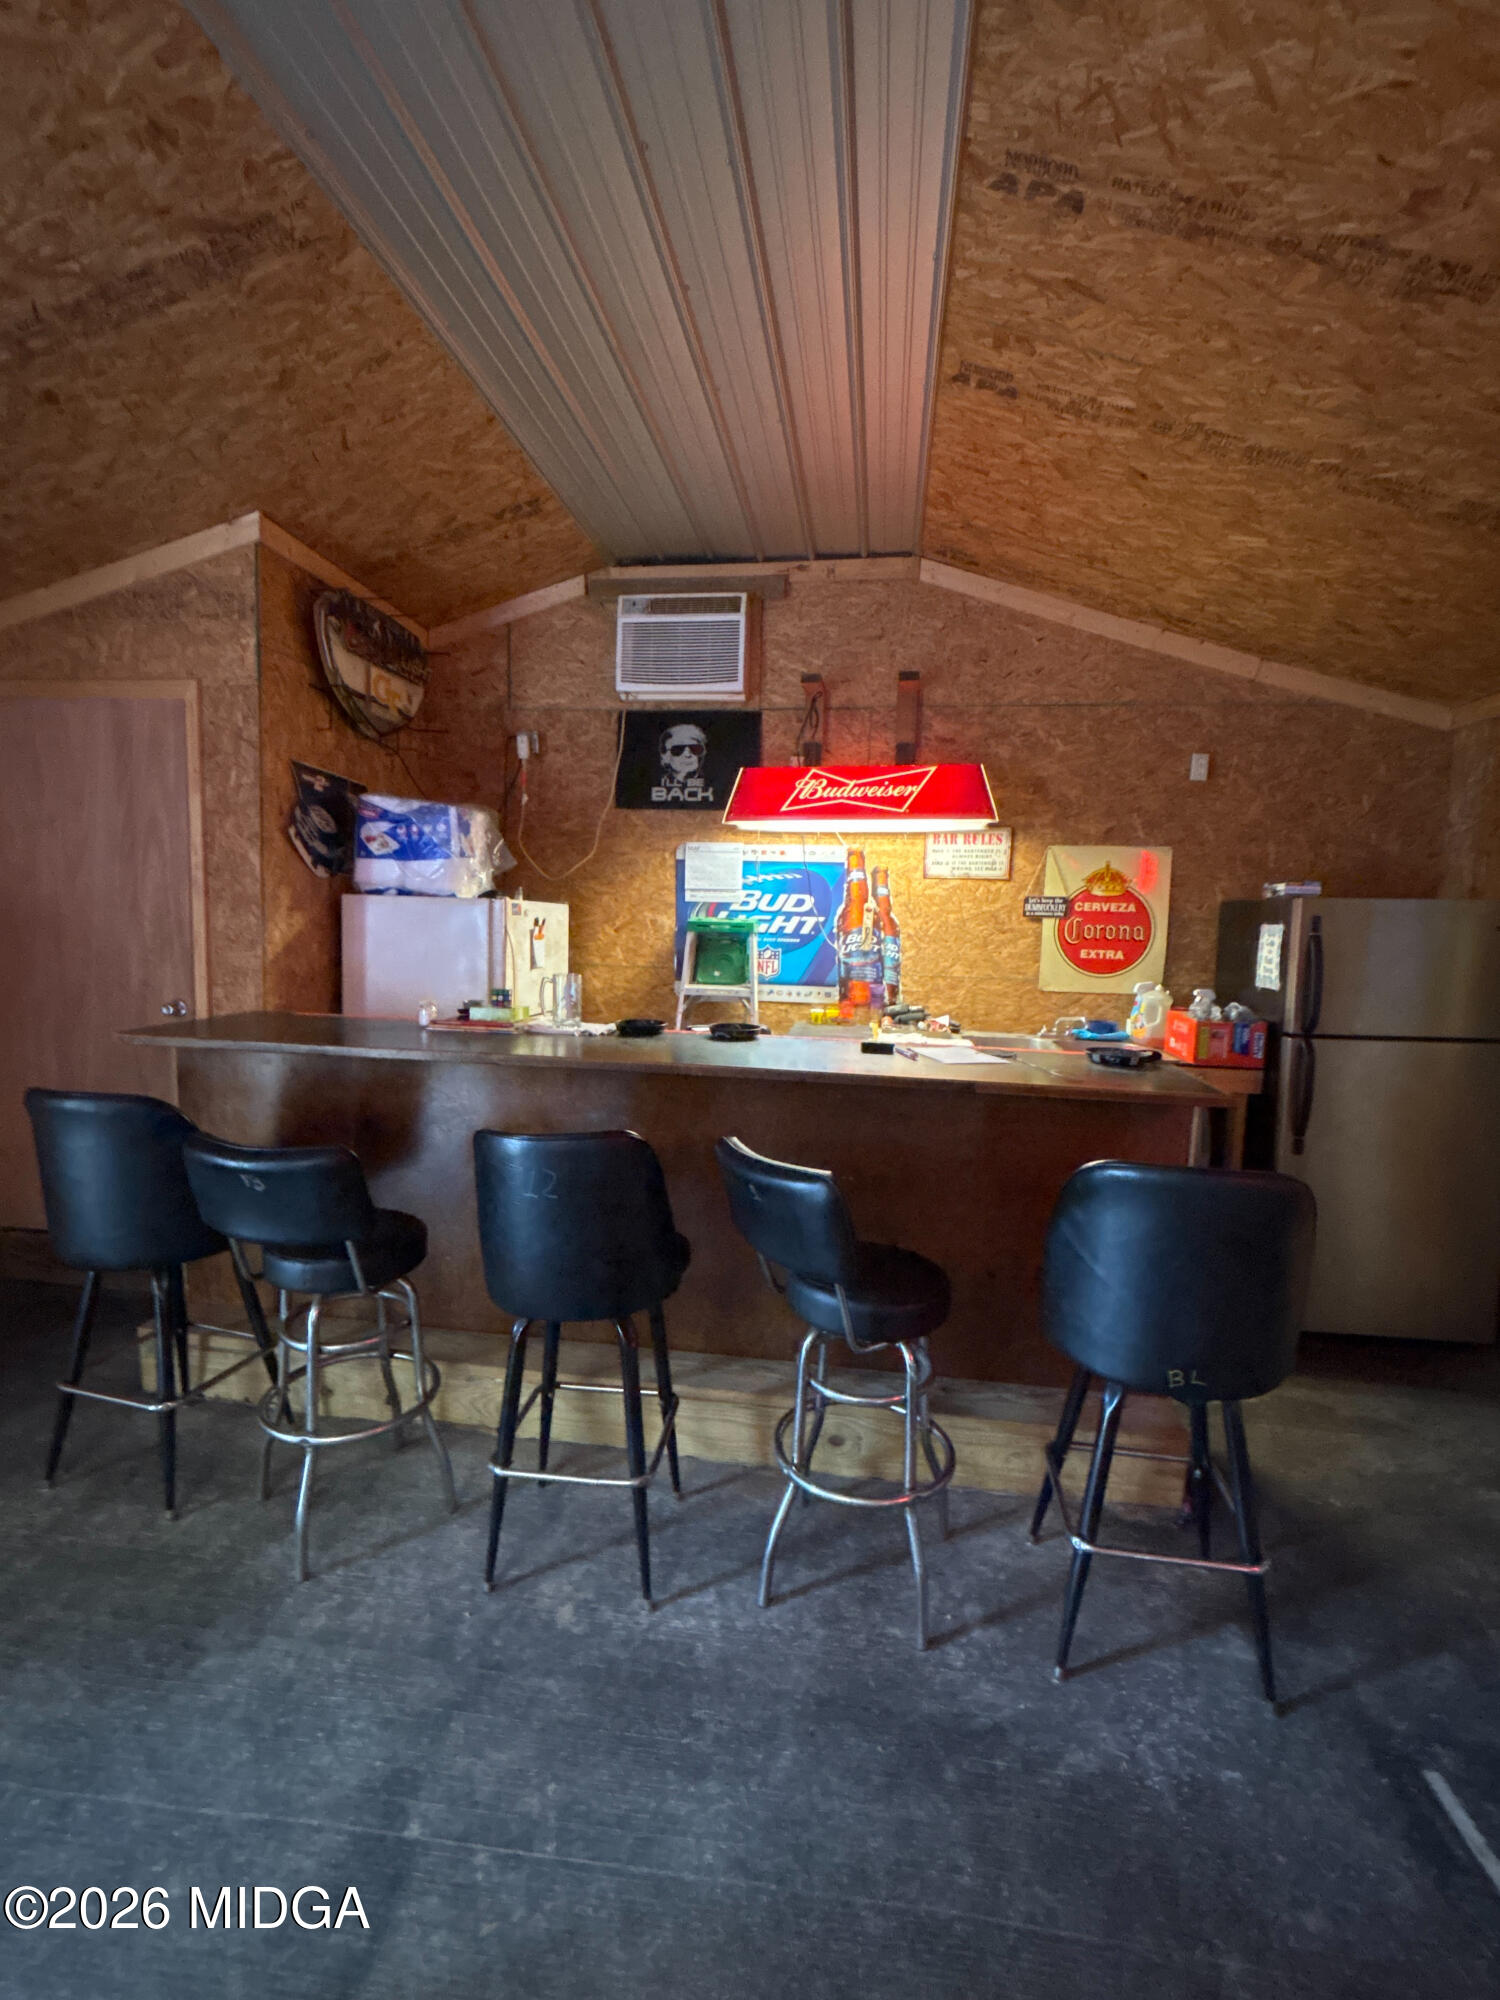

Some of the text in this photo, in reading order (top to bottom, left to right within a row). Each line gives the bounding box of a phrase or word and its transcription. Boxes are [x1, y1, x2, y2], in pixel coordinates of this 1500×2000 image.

[651, 786, 714, 802] BACK
[795, 778, 919, 799] Budweiser
[932, 831, 1003, 845] BAR RULES
[730, 890, 815, 912] BUD
[1074, 901, 1137, 912] CERVEZA
[1064, 916, 1145, 945] Corona
[1080, 949, 1124, 960] EXTRA
[757, 961, 777, 974] NFL
[1169, 1369, 1208, 1388] BL
